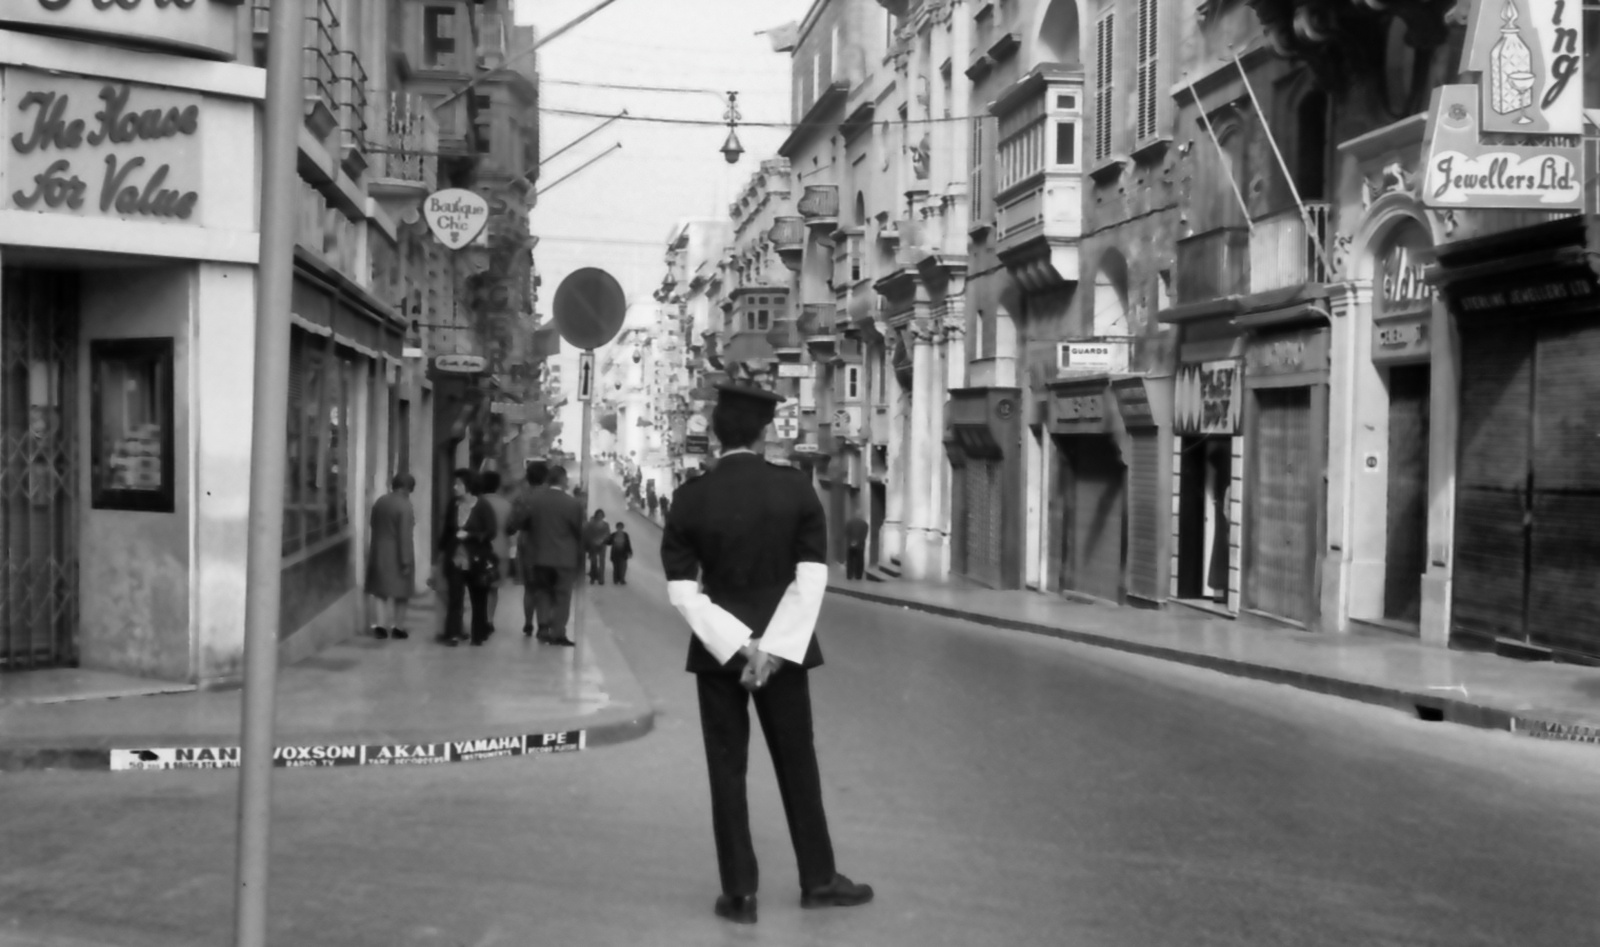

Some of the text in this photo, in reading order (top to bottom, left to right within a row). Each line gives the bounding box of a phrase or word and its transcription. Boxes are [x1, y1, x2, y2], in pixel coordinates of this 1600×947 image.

[11, 83, 199, 154] The House
[1433, 155, 1535, 199] Jewellers
[12, 153, 199, 220] for Value
[430, 196, 485, 219] Boutique
[437, 214, 469, 231] Chic
[1071, 347, 1109, 355] GUARDS
[454, 736, 521, 755] YAMAHA
[542, 732, 567, 746] PE
[376, 743, 435, 759] AKAI
[285, 759, 335, 767] RADIO TV
